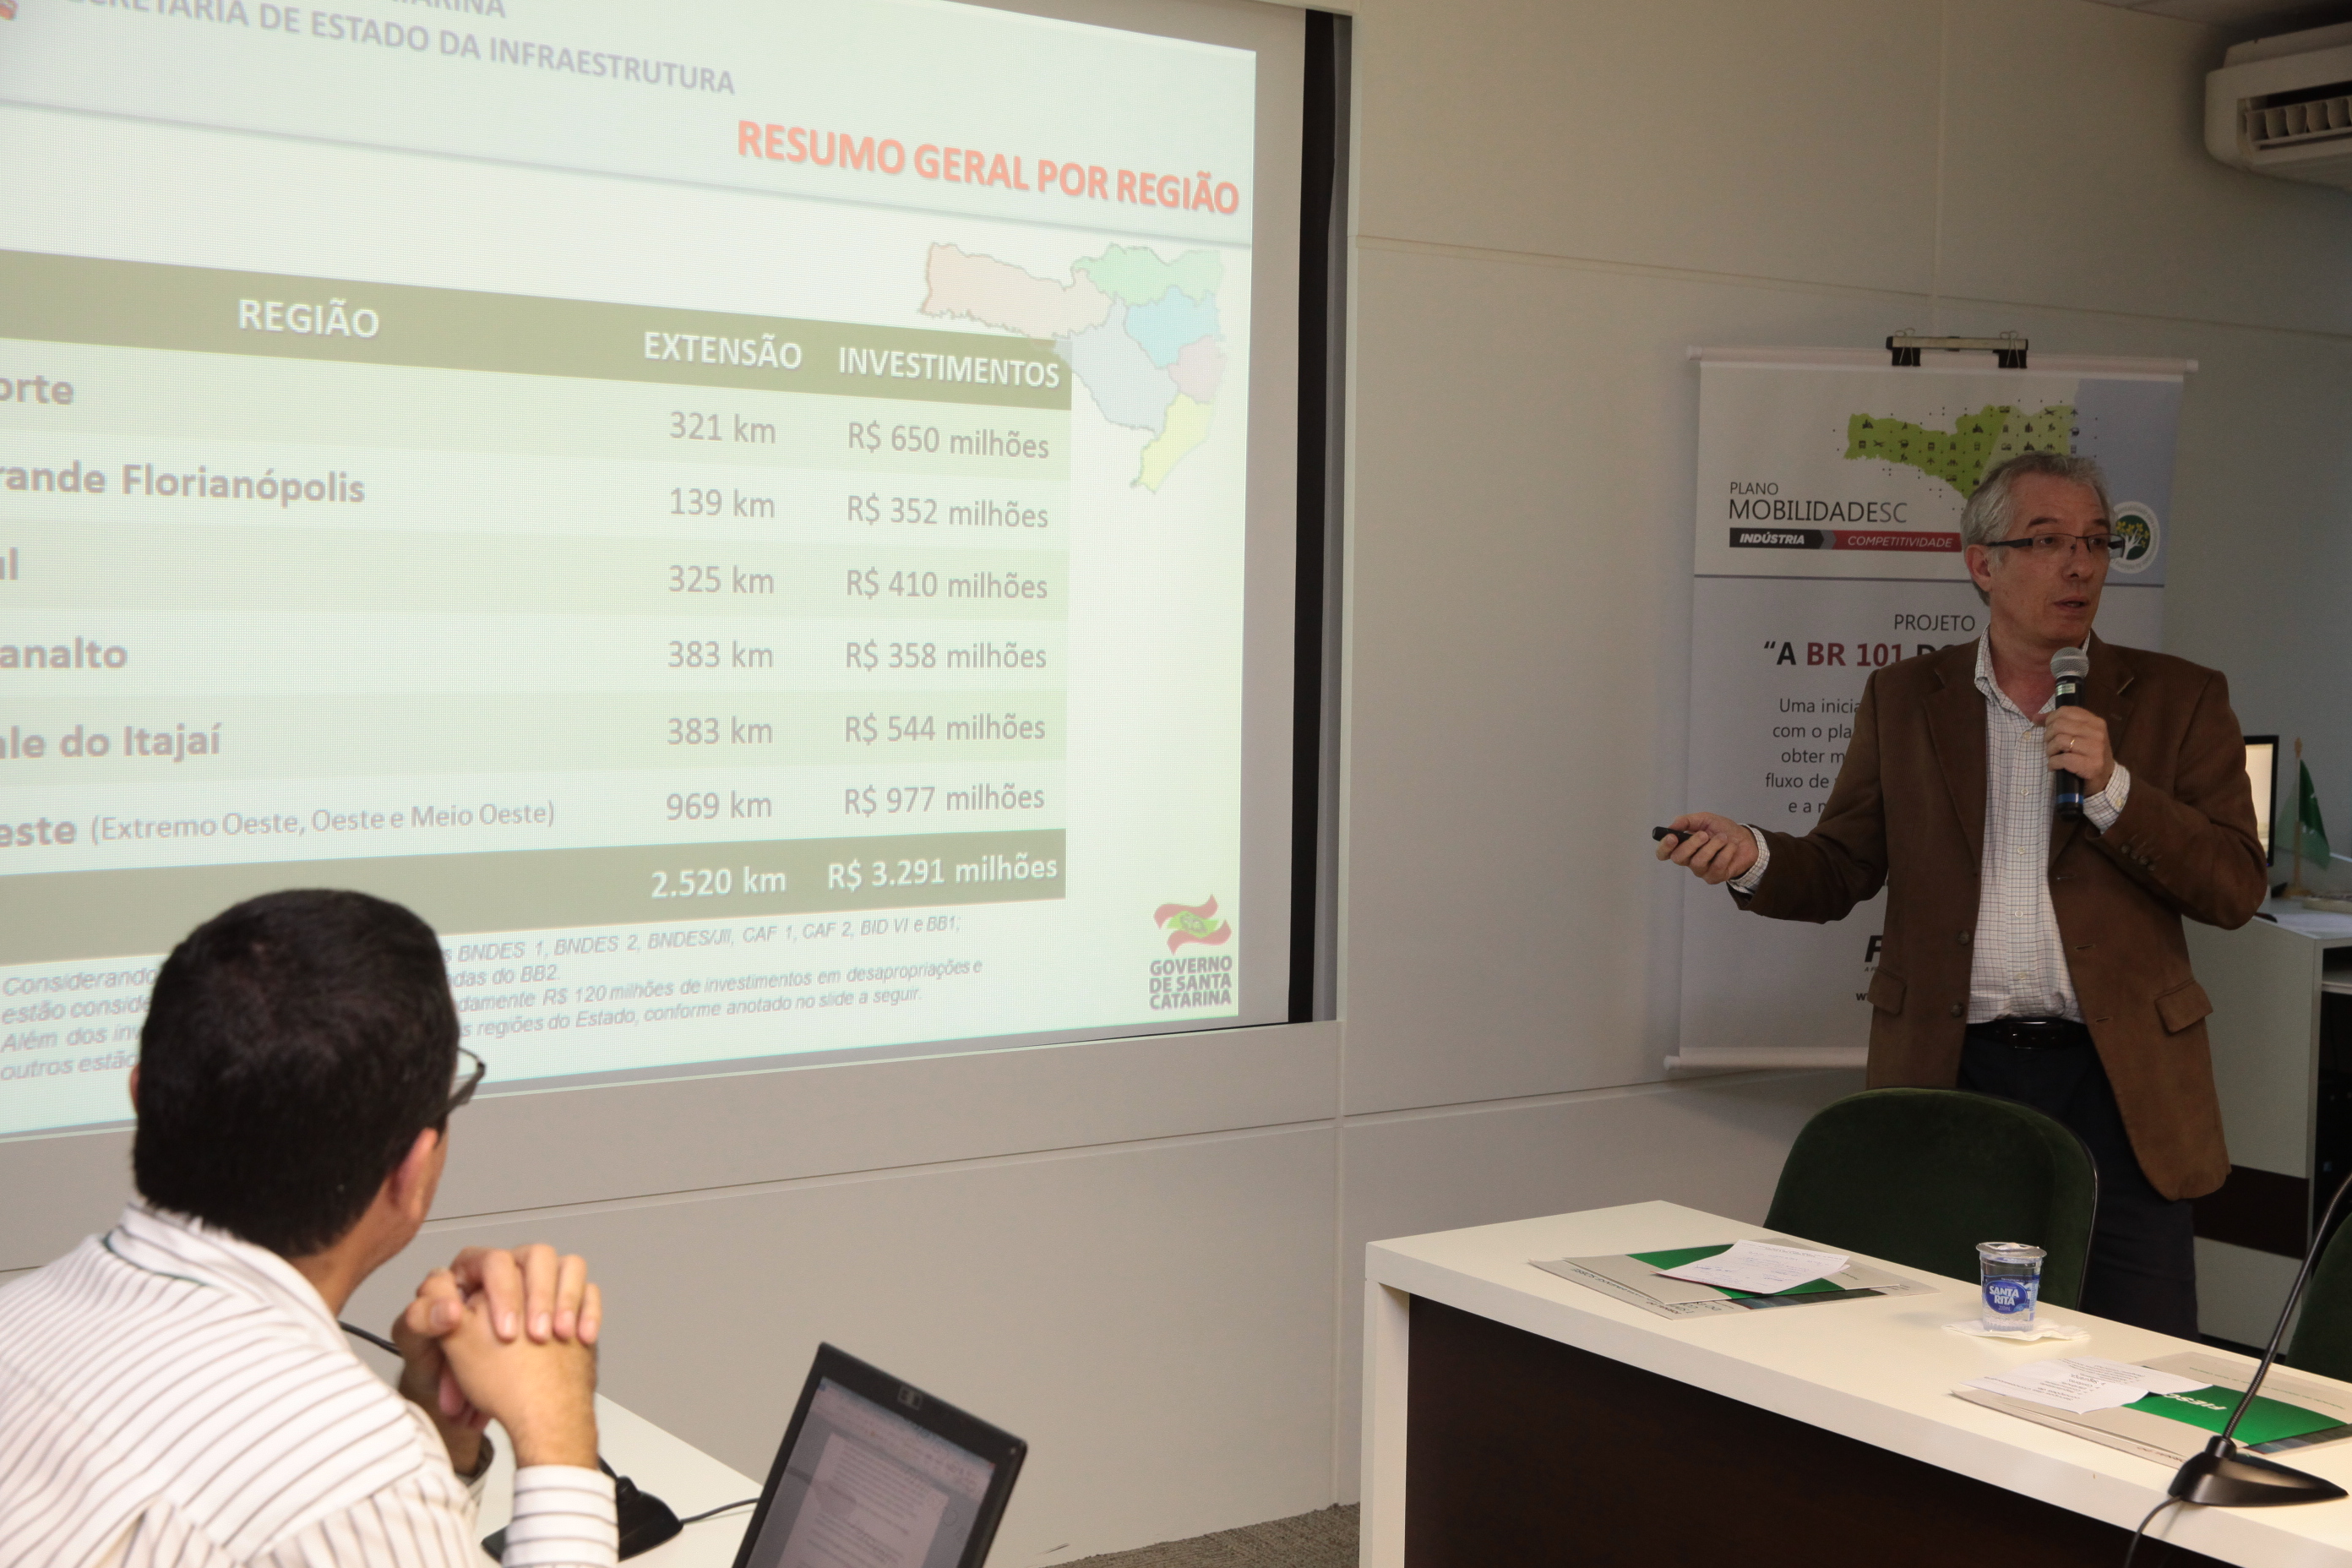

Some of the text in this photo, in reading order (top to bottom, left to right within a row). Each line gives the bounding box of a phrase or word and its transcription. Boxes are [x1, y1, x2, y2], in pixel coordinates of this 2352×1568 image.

[259, 7, 301, 35] DE
[311, 11, 430, 52] ESTADO
[439, 30, 481, 59] DA
[489, 36, 736, 95] INFRAESTRUTURA
[737, 119, 1240, 215] RESUMO GERAL POR REGIÃO
[237, 297, 1061, 389] REGIÃO EXTENSÃO INVESTIMENTOS
[669, 411, 723, 441] 321
[732, 414, 776, 444] km
[847, 420, 882, 454] R$
[890, 425, 940, 453] 650
[949, 429, 1050, 459] milhões
[0, 459, 1049, 528] ande Florianópolis 139 km R$ 352 milhões
[1729, 482, 1779, 496] PLANO
[1729, 498, 1908, 524] MOBILIDADESC
[1739, 531, 1953, 548] INDÚSTRIA COMPETITIVIDADE
[668, 564, 721, 593] 325
[732, 564, 775, 595] km
[846, 566, 879, 600] R$
[888, 570, 939, 598] 410
[947, 572, 1048, 599] milhões
[1893, 613, 1976, 632] PROJETO
[667, 640, 721, 668] 383
[732, 640, 774, 669] km
[845, 638, 879, 672] R$
[887, 642, 937, 668] 358
[946, 642, 1048, 669] milhões
[1806, 641, 1847, 667] BR
[1856, 643, 1902, 667] 101
[1779, 698, 1816, 714] Uma
[0, 712, 1046, 763] le do Itajaí 383 km R$ 544 milhões
[1772, 726, 1806, 738] com
[1811, 727, 1822, 738] o
[1781, 748, 1826, 764] obter
[1765, 772, 1830, 788] fluxo de
[91, 813, 217, 846] (Extremo
[221, 811, 306, 836] Oeste,
[312, 808, 385, 832] Oeste
[389, 814, 404, 830] e
[411, 804, 474, 829] Meio
[478, 799, 555, 829] Oeste)
[666, 792, 720, 821] 969
[730, 790, 772, 819] km
[845, 784, 878, 818] R$
[885, 787, 936, 814] 977
[945, 782, 1045, 812] milhões
[1788, 801, 1798, 814] e
[1803, 802, 1812, 814] a
[651, 852, 1058, 899] 2.520 km R$ 3.291 milhões
[458, 941, 525, 963] BNDES
[554, 934, 619, 957] BNDES
[743, 925, 778, 944] CAF
[803, 921, 837, 940] CAF
[860, 918, 890, 936] BID
[913, 921, 924, 933] e
[1151, 956, 1233, 976] GOVERNO
[1, 999, 66, 1026] estão
[492, 967, 515, 986] do
[1150, 973, 1232, 994] DE SANTA
[0, 1029, 58, 1054] Além
[67, 1026, 108, 1047] dos
[575, 984, 607, 1004] 120
[609, 978, 674, 1000] milhões
[679, 977, 701, 994] de
[703, 970, 814, 994] investimentos
[817, 970, 842, 985] em
[846, 958, 972, 983] desapropriações
[972, 960, 983, 973] e
[1150, 990, 1232, 1010] CATARINA
[1, 1059, 74, 1081] outros
[476, 1015, 544, 1040] regiões
[547, 1013, 571, 1031] do
[575, 1007, 640, 1028] Estado,
[643, 1002, 722, 1022] conforme
[726, 994, 792, 1016] anotado
[794, 994, 816, 1010] no
[818, 990, 855, 1009] slide
[858, 991, 869, 1004] a
[1989, 1285, 2020, 1298] SANTA
[1994, 1294, 2016, 1306] RITA
